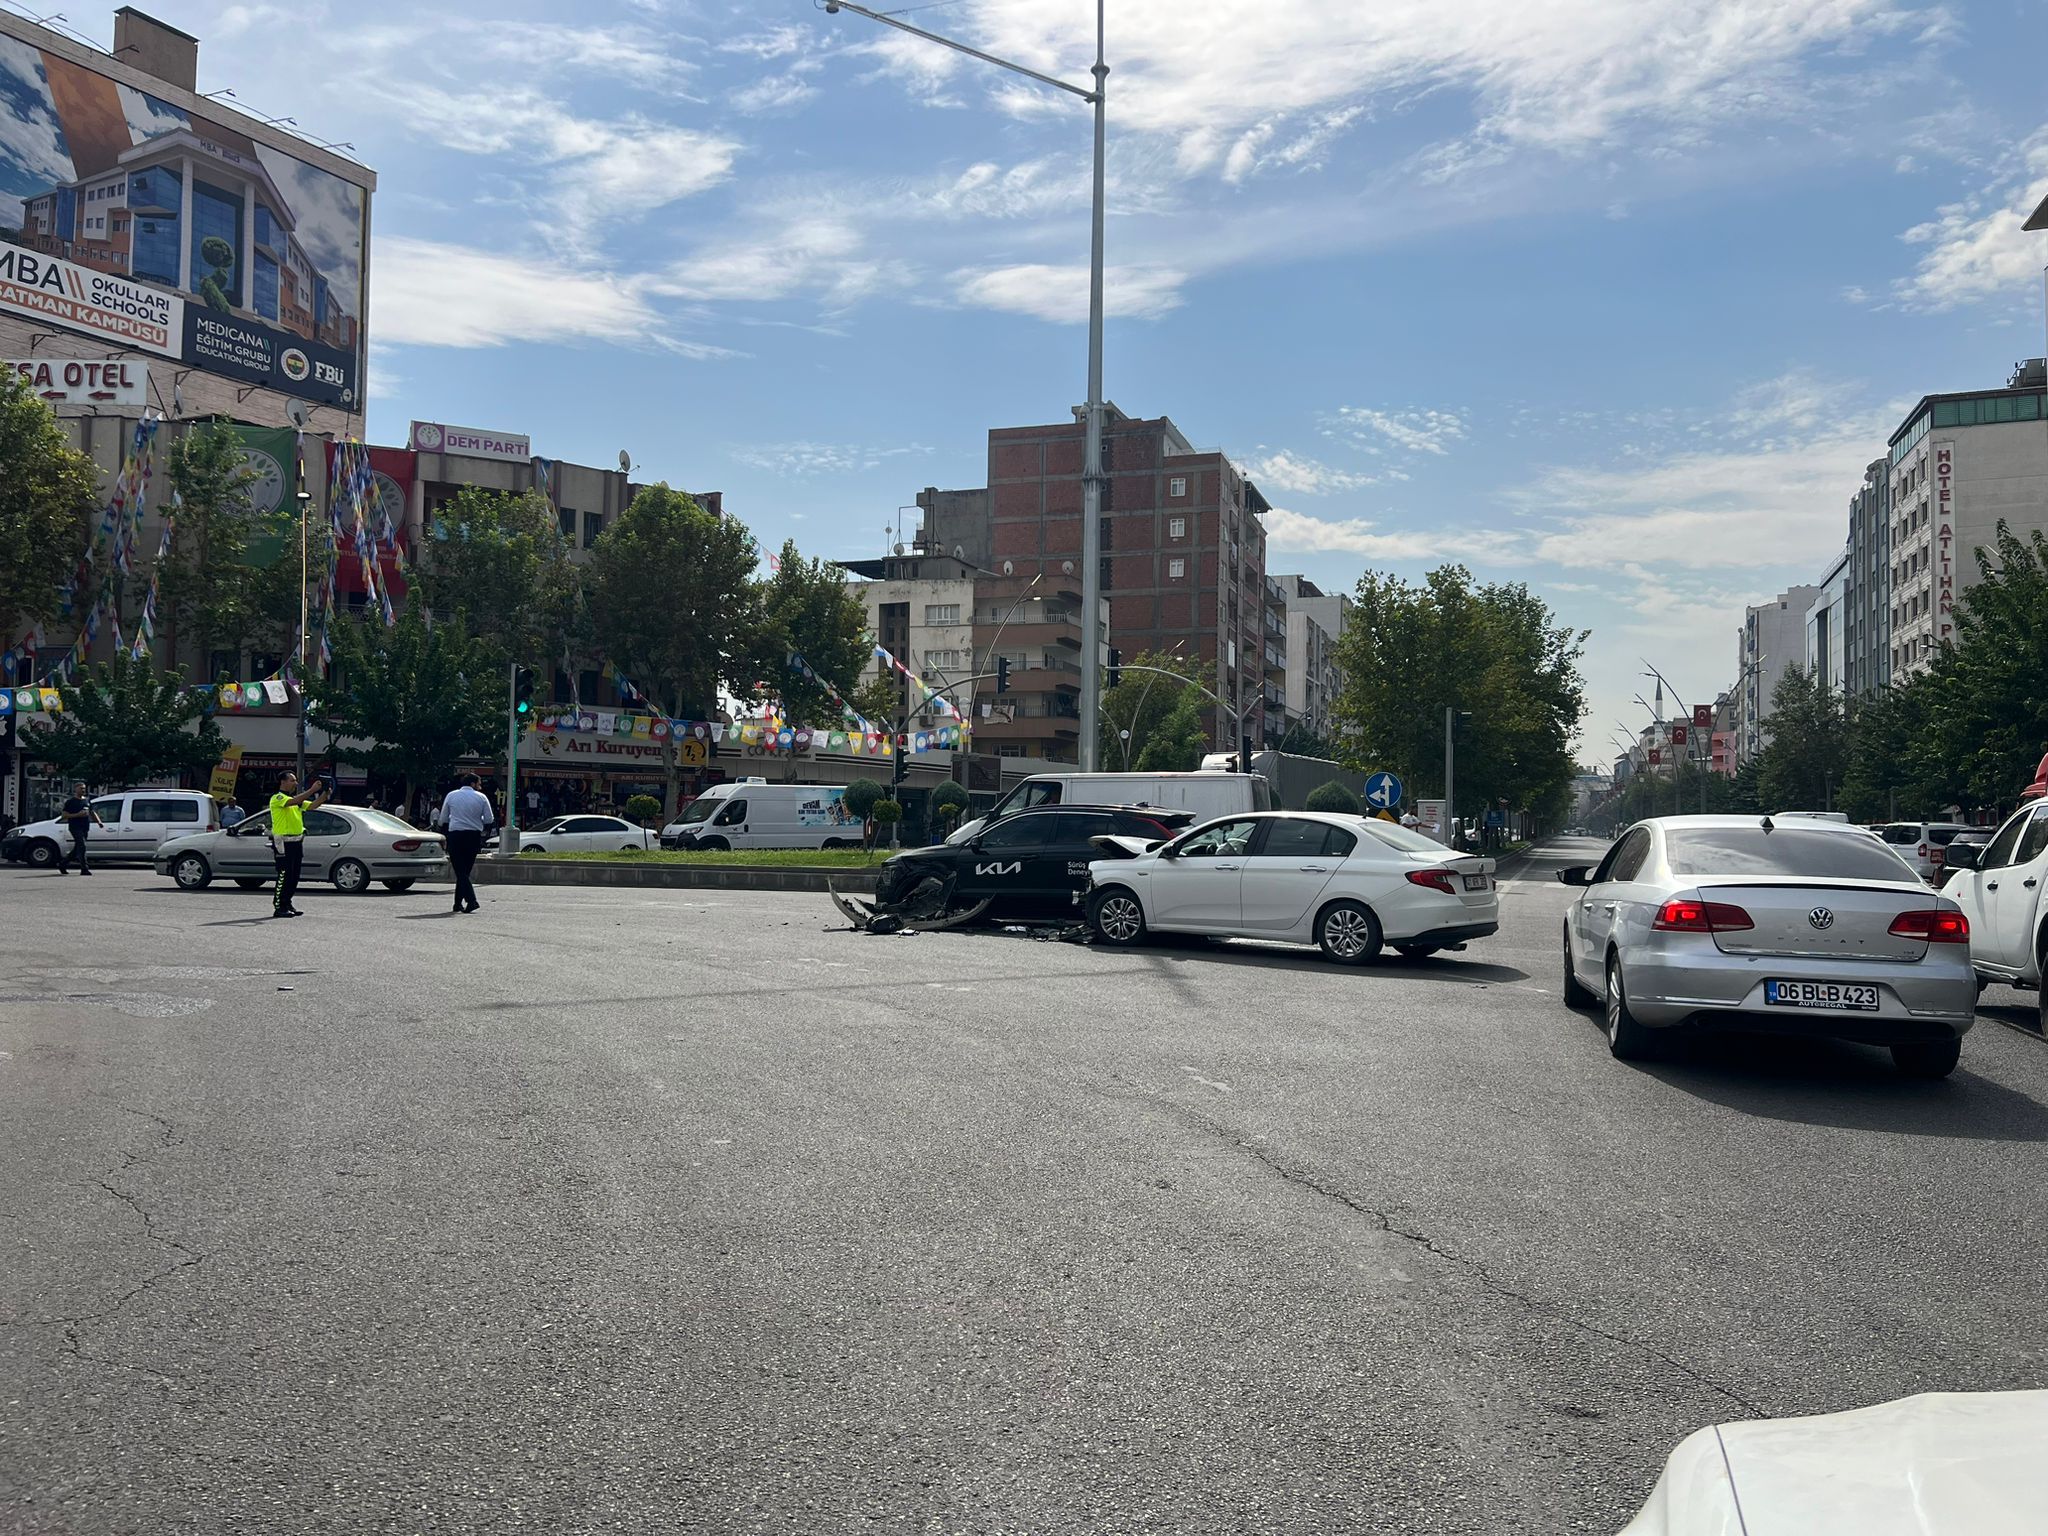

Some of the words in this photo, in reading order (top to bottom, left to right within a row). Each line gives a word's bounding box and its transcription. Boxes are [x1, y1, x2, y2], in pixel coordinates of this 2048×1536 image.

[91, 292, 169, 326] SCHOOLS
[92, 277, 170, 311] OKULLARI
[0, 285, 72, 318] ATMAN
[77, 308, 166, 344] KAMPÜSÜ
[196, 333, 233, 352] EĞİTİM
[234, 345, 271, 364] GRUBU
[197, 318, 264, 350] MEDICANA
[195, 344, 243, 364] EDUCATION
[243, 359, 271, 373] GROUP
[314, 361, 345, 385] FBÜ
[64, 362, 134, 388] OTEL
[447, 435, 480, 450] DEM
[483, 440, 529, 456] PARTİ
[1938, 450, 1952, 515] HOTEL
[1939, 523, 1953, 616] ATLIHAN
[566, 738, 592, 754] Arı
[975, 861, 1021, 875] KIA
[1777, 983, 1799, 1000] 06
[1802, 984, 1840, 1002] BLB
[1843, 987, 1876, 1005] 423
